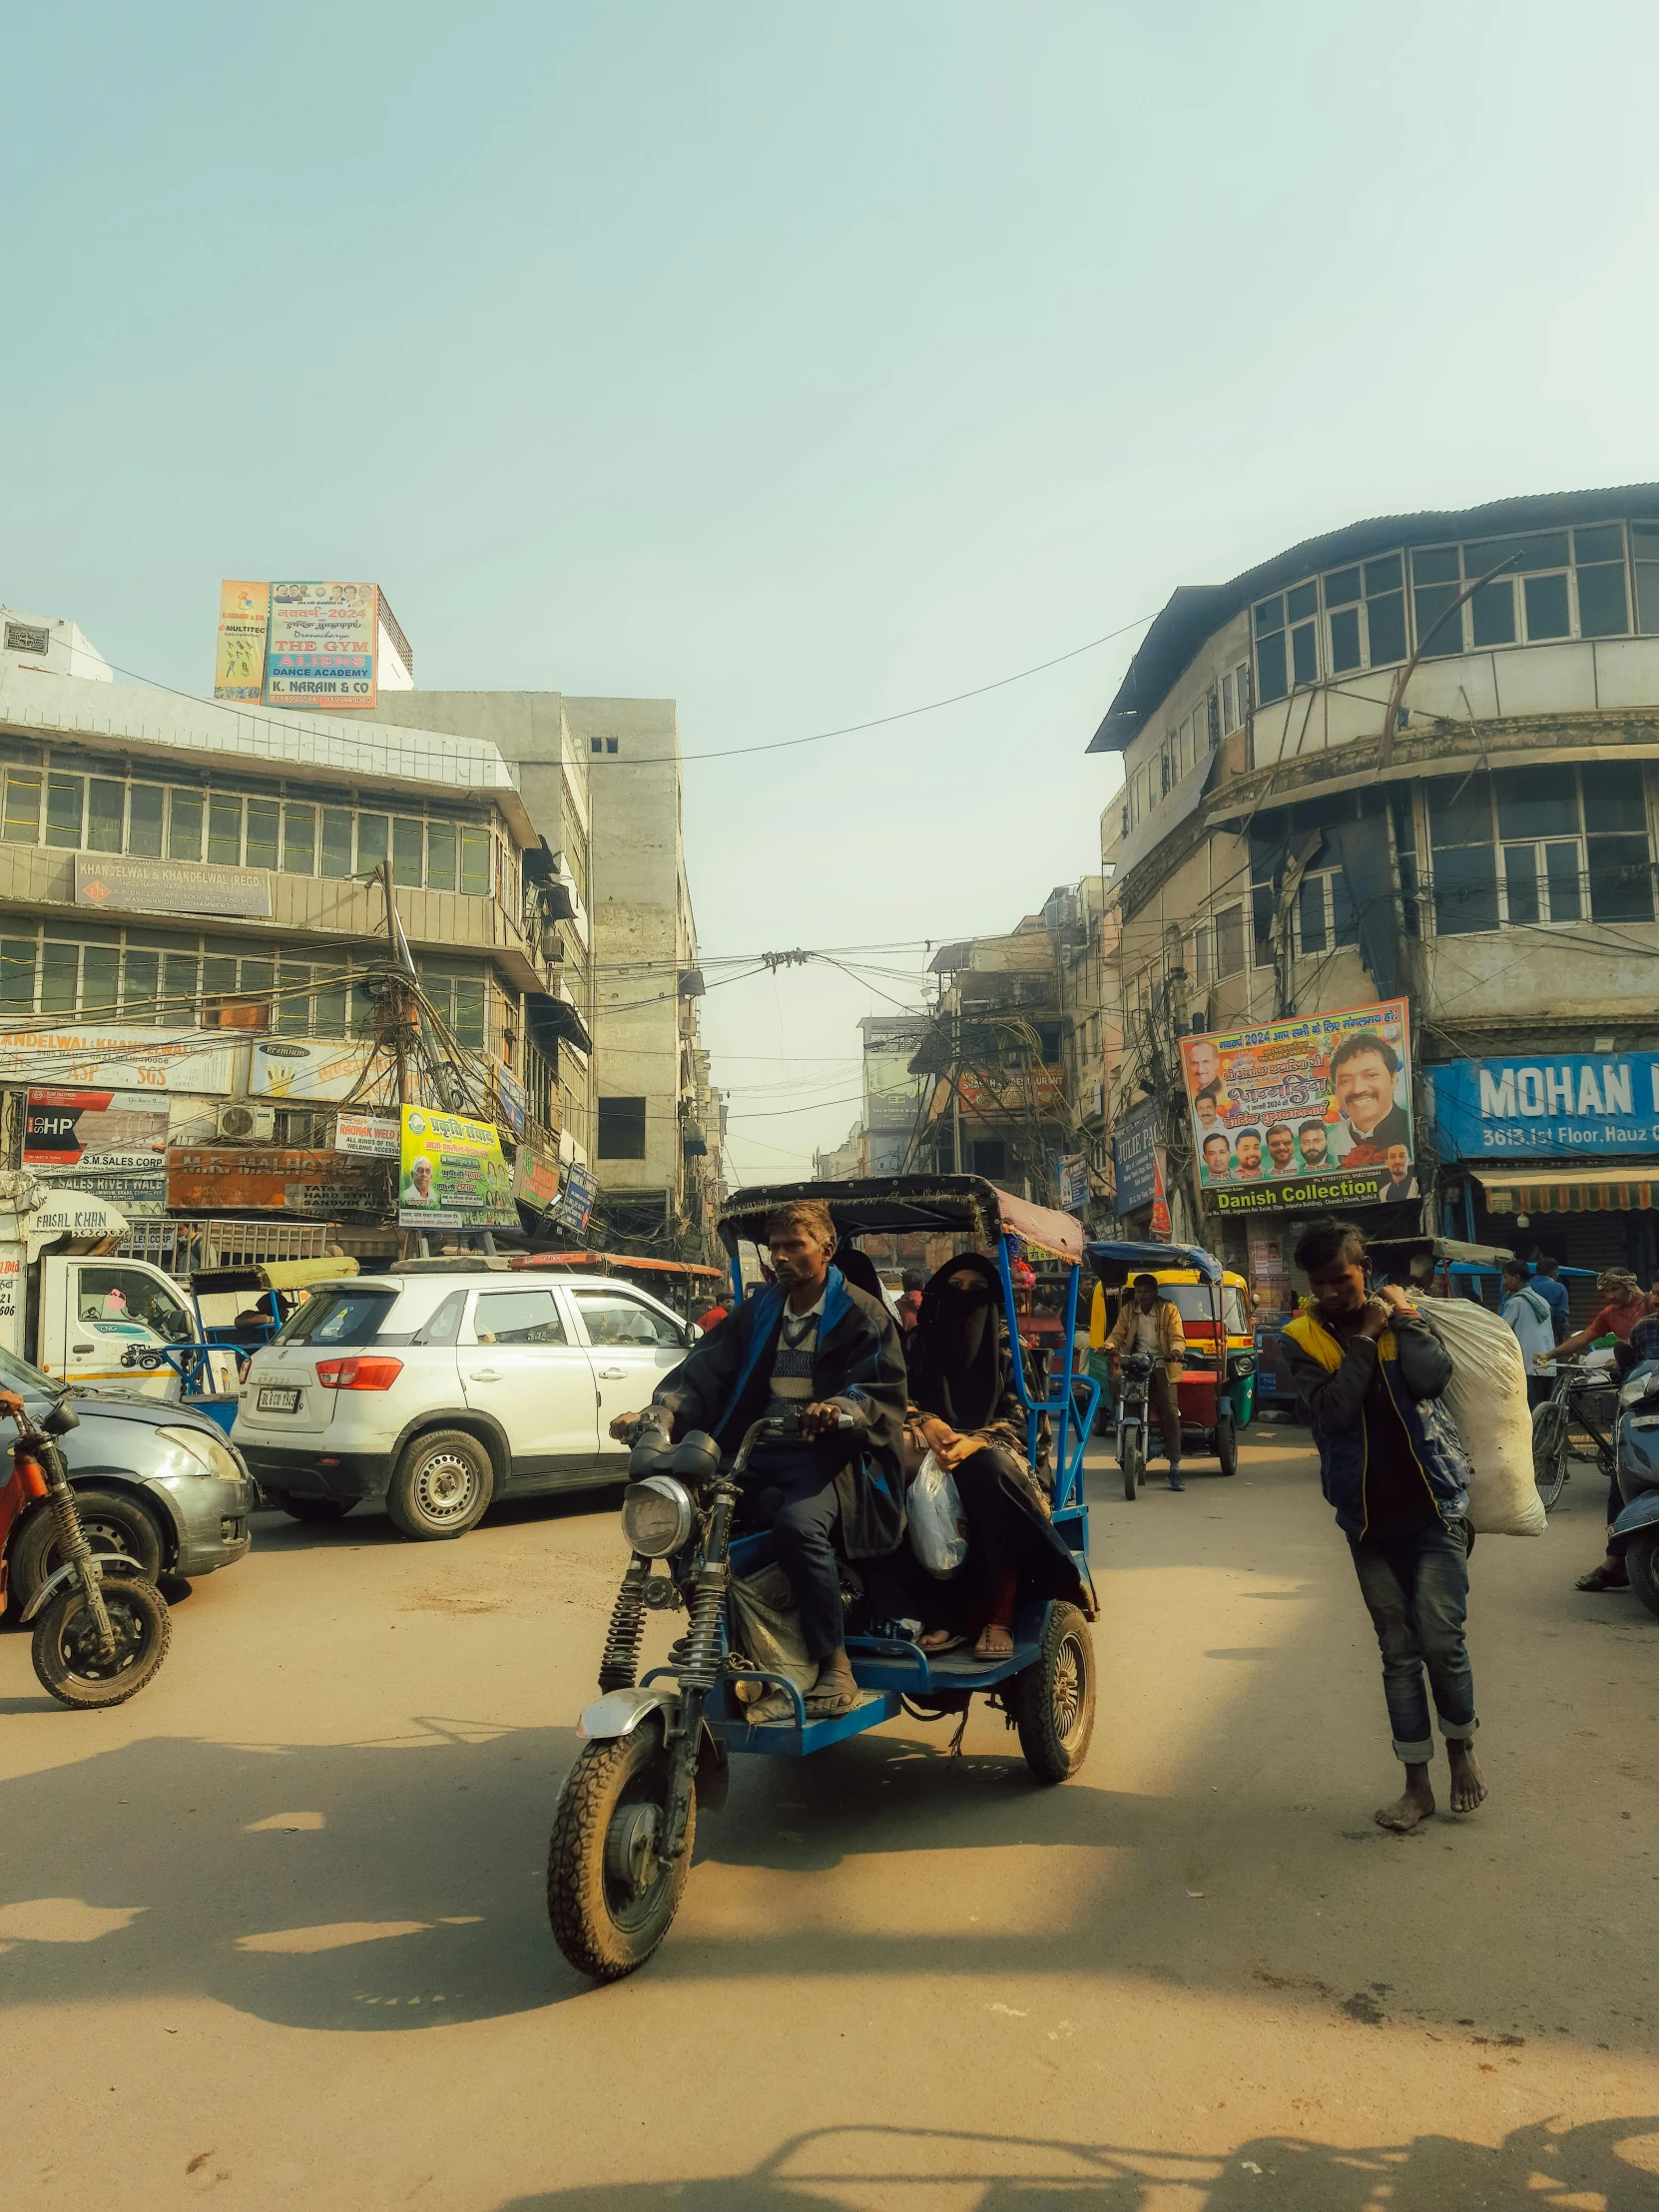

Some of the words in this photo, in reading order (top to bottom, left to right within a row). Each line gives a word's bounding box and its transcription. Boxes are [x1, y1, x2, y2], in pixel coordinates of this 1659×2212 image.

[276, 641, 316, 652] THE
[323, 641, 369, 652] GYM
[277, 655, 366, 667] ALIENS
[273, 682, 284, 692] K.
[289, 682, 335, 693] NARAIN
[340, 683, 349, 693] &
[353, 683, 369, 693] CO
[80, 863, 149, 880] KHANDELWAL
[162, 869, 228, 886] KHANDELWAL
[126, 896, 162, 905] MASONRY
[1245, 1032, 1270, 1046] 2024
[1273, 1032, 1290, 1042] आप
[1292, 1025, 1309, 1038] सभी
[1312, 1025, 1322, 1035] के
[1324, 1020, 1340, 1033] लिए
[1342, 1016, 1382, 1030] मंगलमय
[266, 1046, 305, 1058] Premium
[1310, 1054, 1324, 1066] जी
[138, 1066, 166, 1086] SGS
[1228, 1074, 1328, 1105] जन्मदिन
[1479, 1063, 1634, 1118] MOHAN
[44, 1118, 73, 1135] HP
[1224, 1112, 1260, 1127] हार्दिक
[339, 1124, 372, 1138] RAUNAK
[374, 1128, 395, 1140] WELD
[430, 1118, 463, 1139] प्रकृति
[464, 1124, 494, 1144] संवाद
[1606, 1126, 1647, 1142] Hauz
[1118, 1132, 1142, 1164] JULIE
[83, 1156, 133, 1166] S.M.SALES
[136, 1158, 163, 1167] CORP
[183, 1156, 231, 1175] M.R.
[59, 1178, 93, 1189] SALES
[1218, 1189, 1277, 1209] Danish
[1282, 1180, 1378, 1204] Collection
[36, 1212, 71, 1228] FAISAL
[74, 1212, 107, 1227] KHAN
